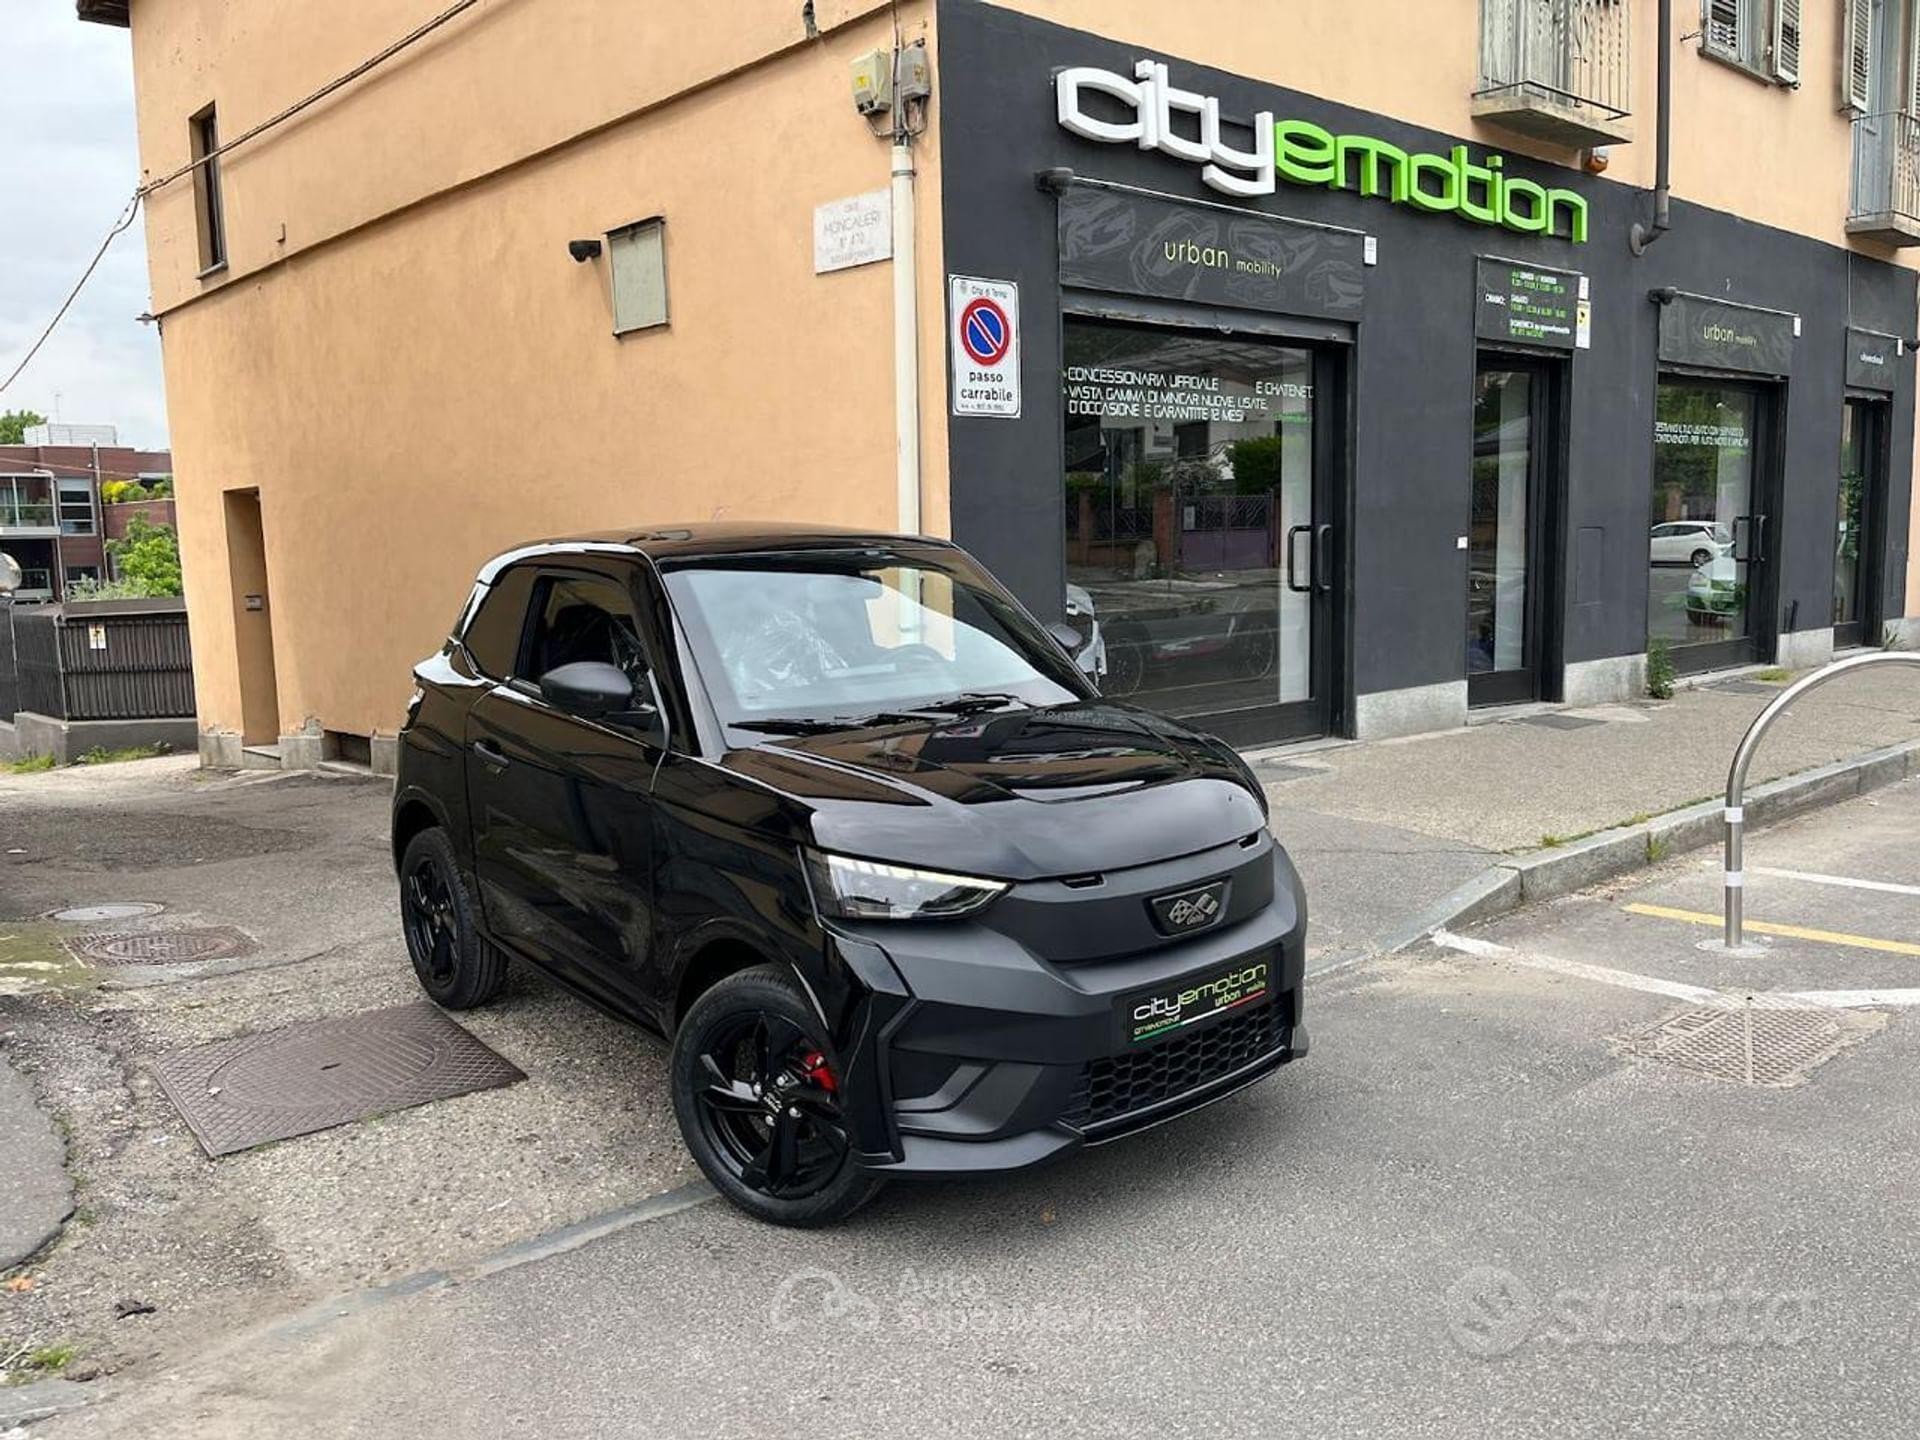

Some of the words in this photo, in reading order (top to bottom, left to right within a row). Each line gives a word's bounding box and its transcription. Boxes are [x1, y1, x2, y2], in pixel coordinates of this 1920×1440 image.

[1164, 240, 1229, 269] urban
[1236, 260, 1282, 280] mobility
[1703, 324, 1734, 343] urban
[969, 369, 1003, 383] passo
[1067, 367, 1167, 387] CONCESSIONARIA
[1168, 374, 1220, 391] UFFICIALE
[1255, 381, 1263, 394] E
[961, 386, 1013, 401] carrabile
[1068, 384, 1104, 400] VASTA
[1105, 387, 1146, 402] GAMMA
[1147, 390, 1159, 403] DI
[1143, 403, 1152, 418] E
[1153, 404, 1209, 420] GARANTITE
[1133, 963, 1267, 1020] cityemotion
[1214, 990, 1242, 1008] urban
